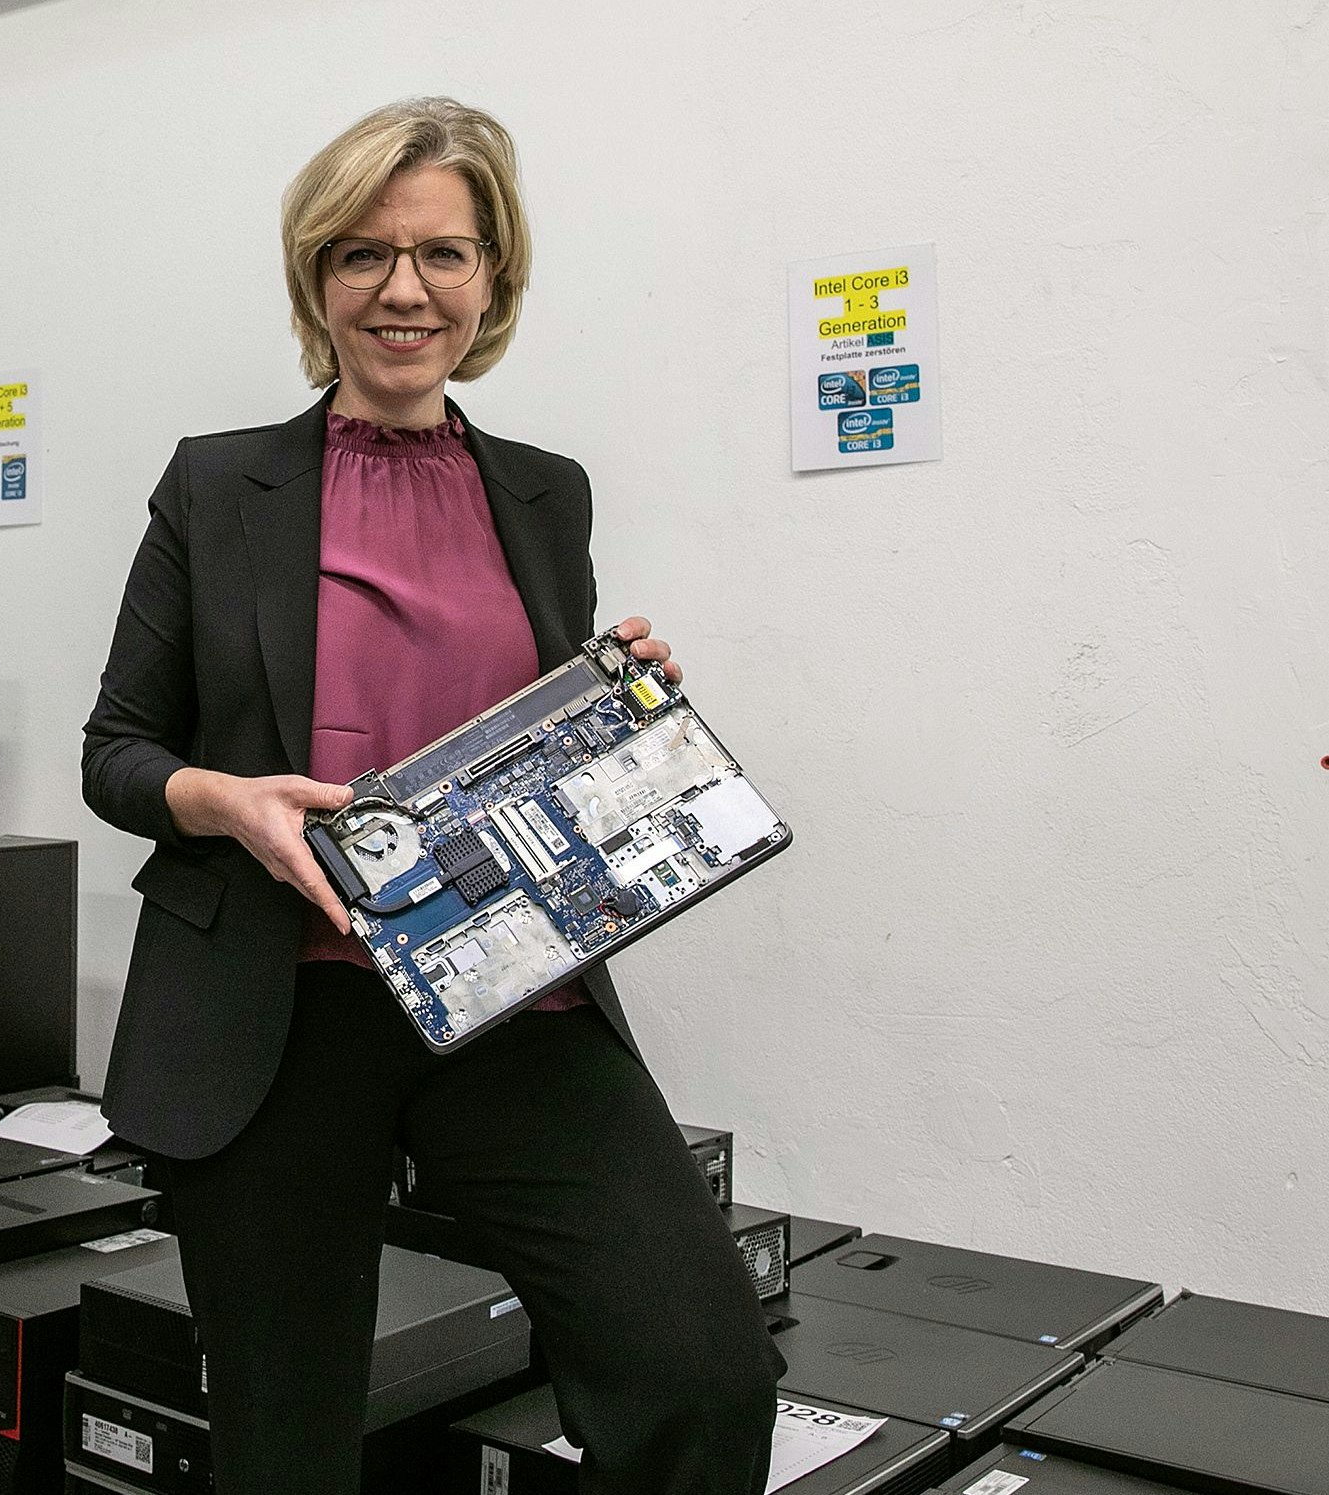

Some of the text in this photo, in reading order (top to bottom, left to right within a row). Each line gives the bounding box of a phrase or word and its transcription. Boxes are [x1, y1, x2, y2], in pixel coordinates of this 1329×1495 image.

[814, 270, 909, 296] Intel Core i3
[844, 299, 852, 312] 1
[869, 295, 879, 310] 3
[819, 315, 906, 336] Generation
[831, 337, 864, 350] Artikel
[820, 346, 906, 362] Festplatte zerstören
[20, 384, 28, 395] i3
[820, 394, 846, 405] CORE
[877, 394, 897, 403] CORE
[7, 402, 13, 412] 5
[846, 441, 869, 450] CORE
